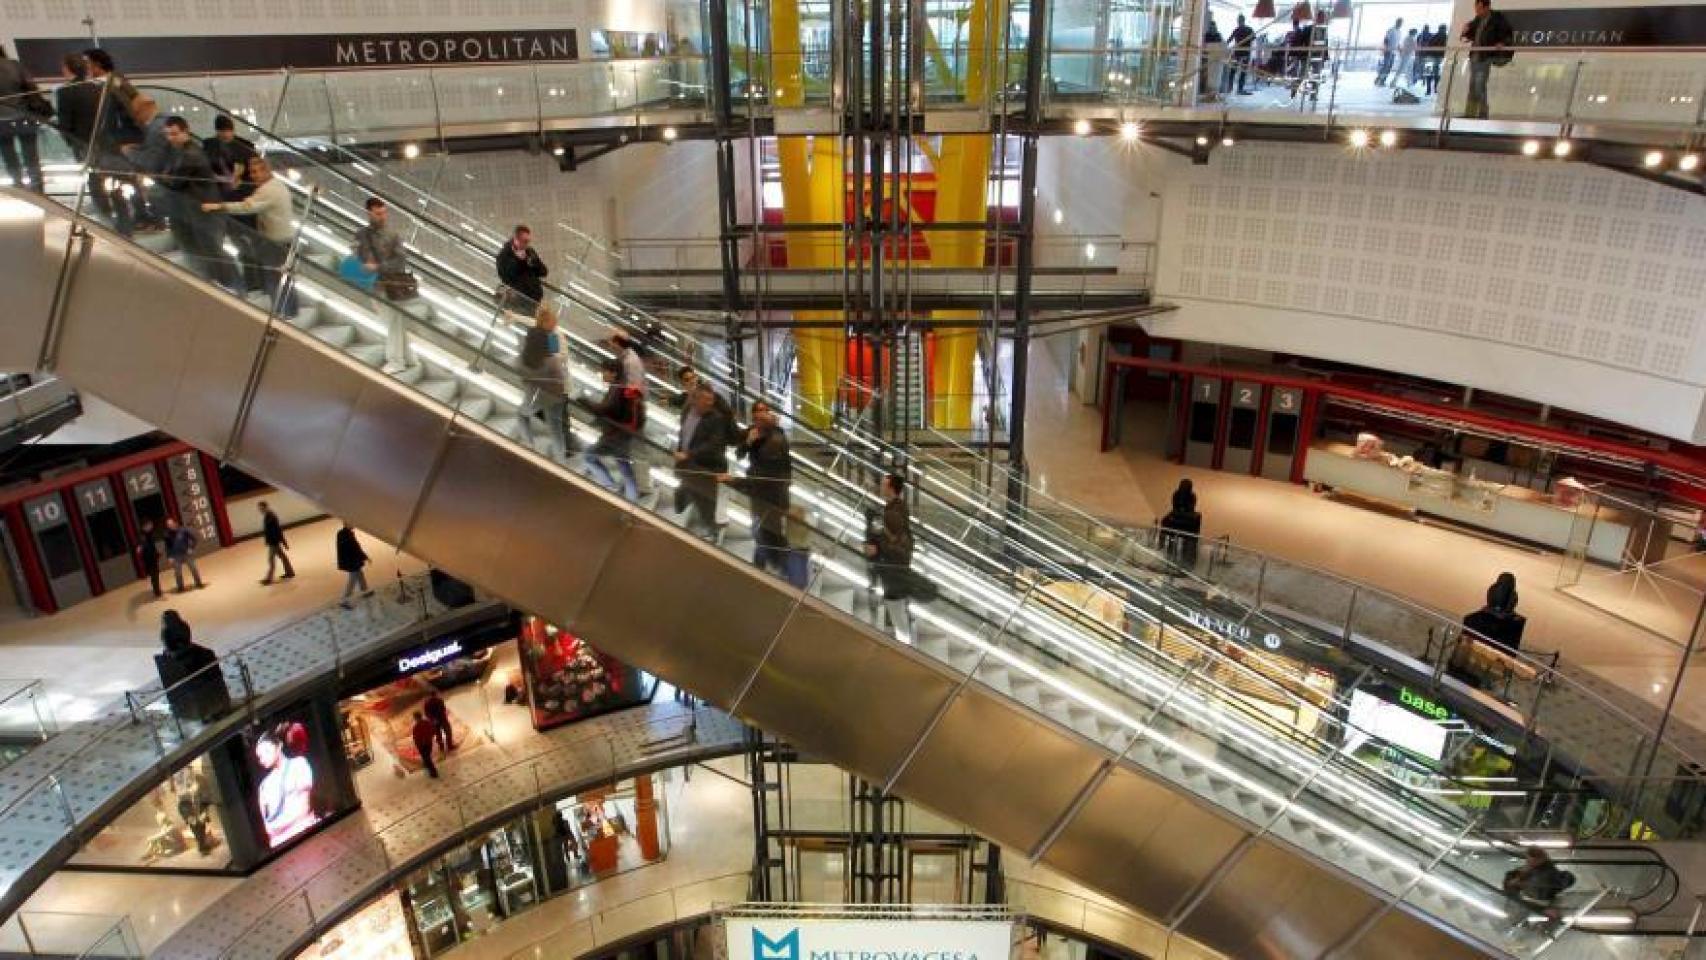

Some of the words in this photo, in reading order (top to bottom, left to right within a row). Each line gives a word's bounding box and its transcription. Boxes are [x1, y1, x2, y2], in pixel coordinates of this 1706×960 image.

[1512, 31, 1624, 44] TROPOLITAN
[336, 36, 569, 63] METROPOLITAN
[1201, 385, 1211, 399] 1
[1239, 388, 1251, 403] 2
[1279, 393, 1293, 409] 3
[128, 472, 156, 492] 12
[191, 482, 201, 495] 9
[84, 487, 108, 508] 11
[192, 496, 207, 511] 10
[32, 501, 60, 523] 10
[195, 511, 210, 526] 11
[200, 526, 215, 539] 12
